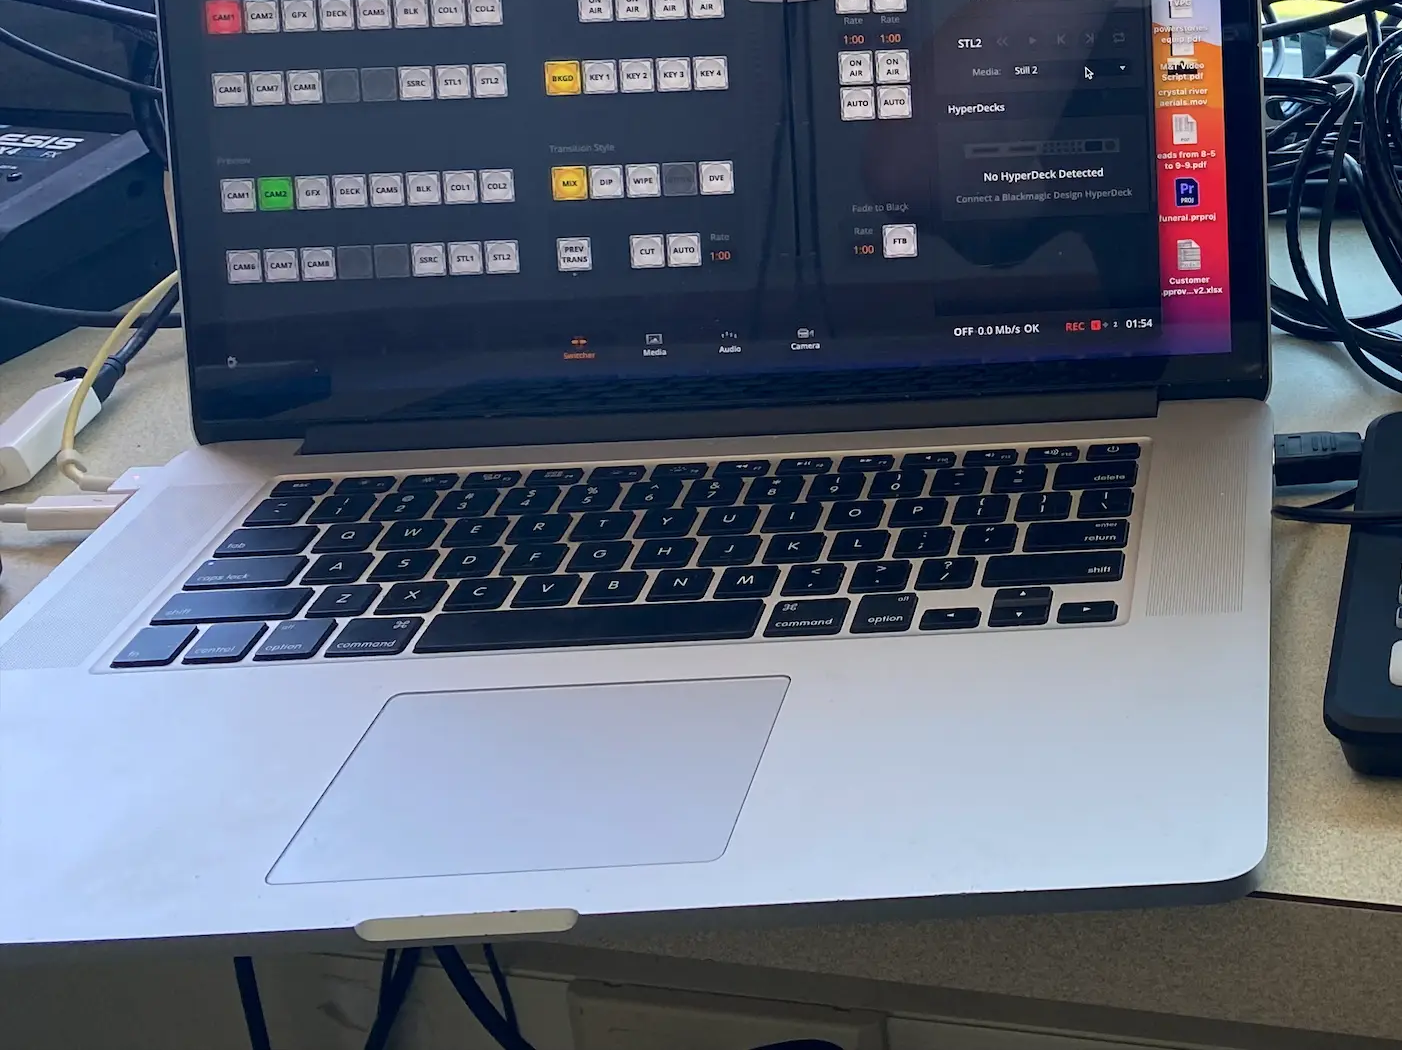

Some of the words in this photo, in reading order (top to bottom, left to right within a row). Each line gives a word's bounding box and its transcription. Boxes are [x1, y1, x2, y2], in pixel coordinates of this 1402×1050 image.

[326, 9, 347, 18] DECK
[438, 6, 458, 15] COL1
[1158, 87, 1187, 97] crystal
[1188, 87, 1208, 96] river
[846, 99, 869, 108] AUTO
[948, 103, 1005, 115] HyperDecks
[983, 172, 998, 182] No
[1001, 169, 1056, 182] HyperDeck
[1058, 168, 1104, 179] Detected
[562, 179, 577, 188] MIX
[633, 177, 653, 185] WIPE
[709, 174, 724, 183] DVE
[640, 247, 655, 256] CUT
[1169, 276, 1210, 285] Customer
[954, 327, 974, 336] OFF
[977, 326, 993, 335] 0.0
[995, 324, 1020, 335] Mb/s
[1024, 323, 1040, 333] OK
[1065, 322, 1085, 332] REC
[1125, 318, 1153, 329] 01:54
[791, 341, 820, 351] Camera
[1093, 473, 1126, 482] delete
[1084, 534, 1117, 543] return
[775, 617, 834, 627] command
[867, 613, 904, 625] option
[336, 639, 397, 650] command
